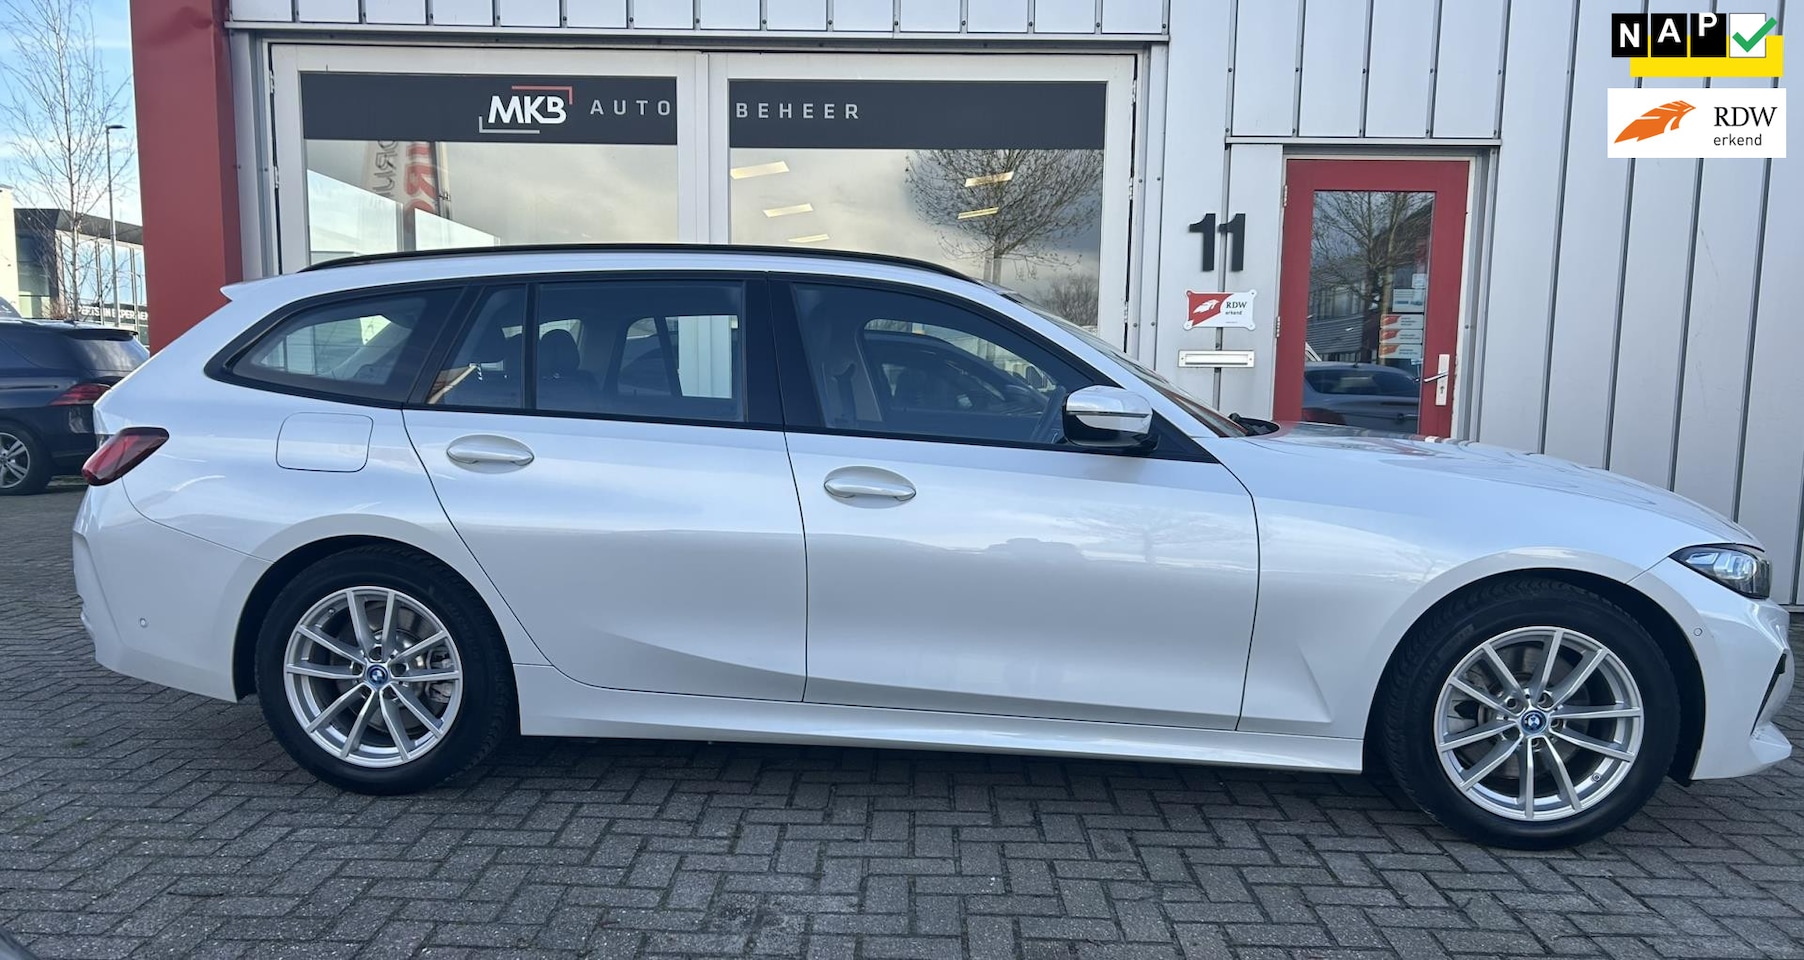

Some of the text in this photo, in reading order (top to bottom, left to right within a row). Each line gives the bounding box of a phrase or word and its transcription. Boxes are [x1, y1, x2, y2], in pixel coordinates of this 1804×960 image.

[488, 95, 859, 124] MKB AUTO BEHEER
[1188, 212, 1246, 272] 11
[1226, 301, 1247, 309] RDW
